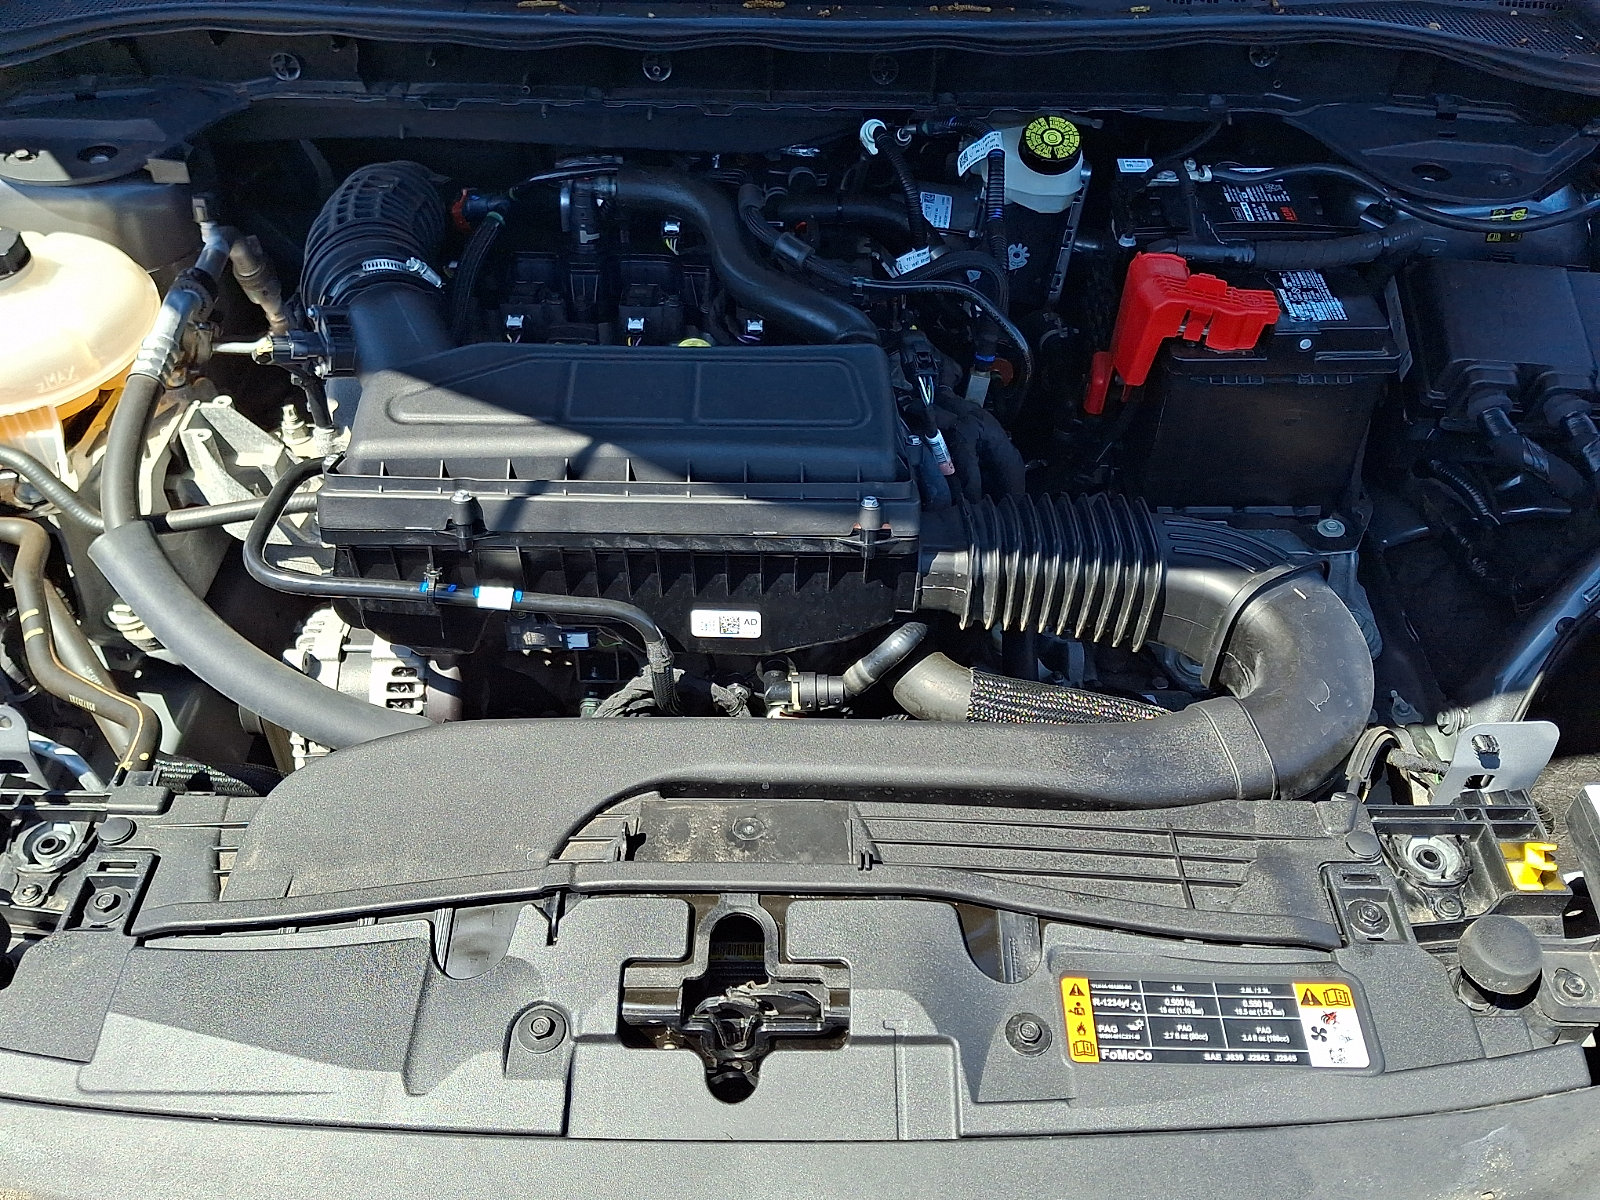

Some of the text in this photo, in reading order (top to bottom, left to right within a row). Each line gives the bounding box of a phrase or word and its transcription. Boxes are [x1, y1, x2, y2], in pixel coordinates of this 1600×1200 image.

[744, 618, 758, 626] AD
[1164, 998, 1195, 1009] 0.500 kg
[1262, 999, 1273, 1010] kg
[1098, 1024, 1118, 1033] PAG
[1177, 1024, 1192, 1032] PAG
[1256, 1026, 1272, 1034] PAG
[1101, 1050, 1152, 1061] FoMoCo
[1203, 1053, 1222, 1061] SAE
